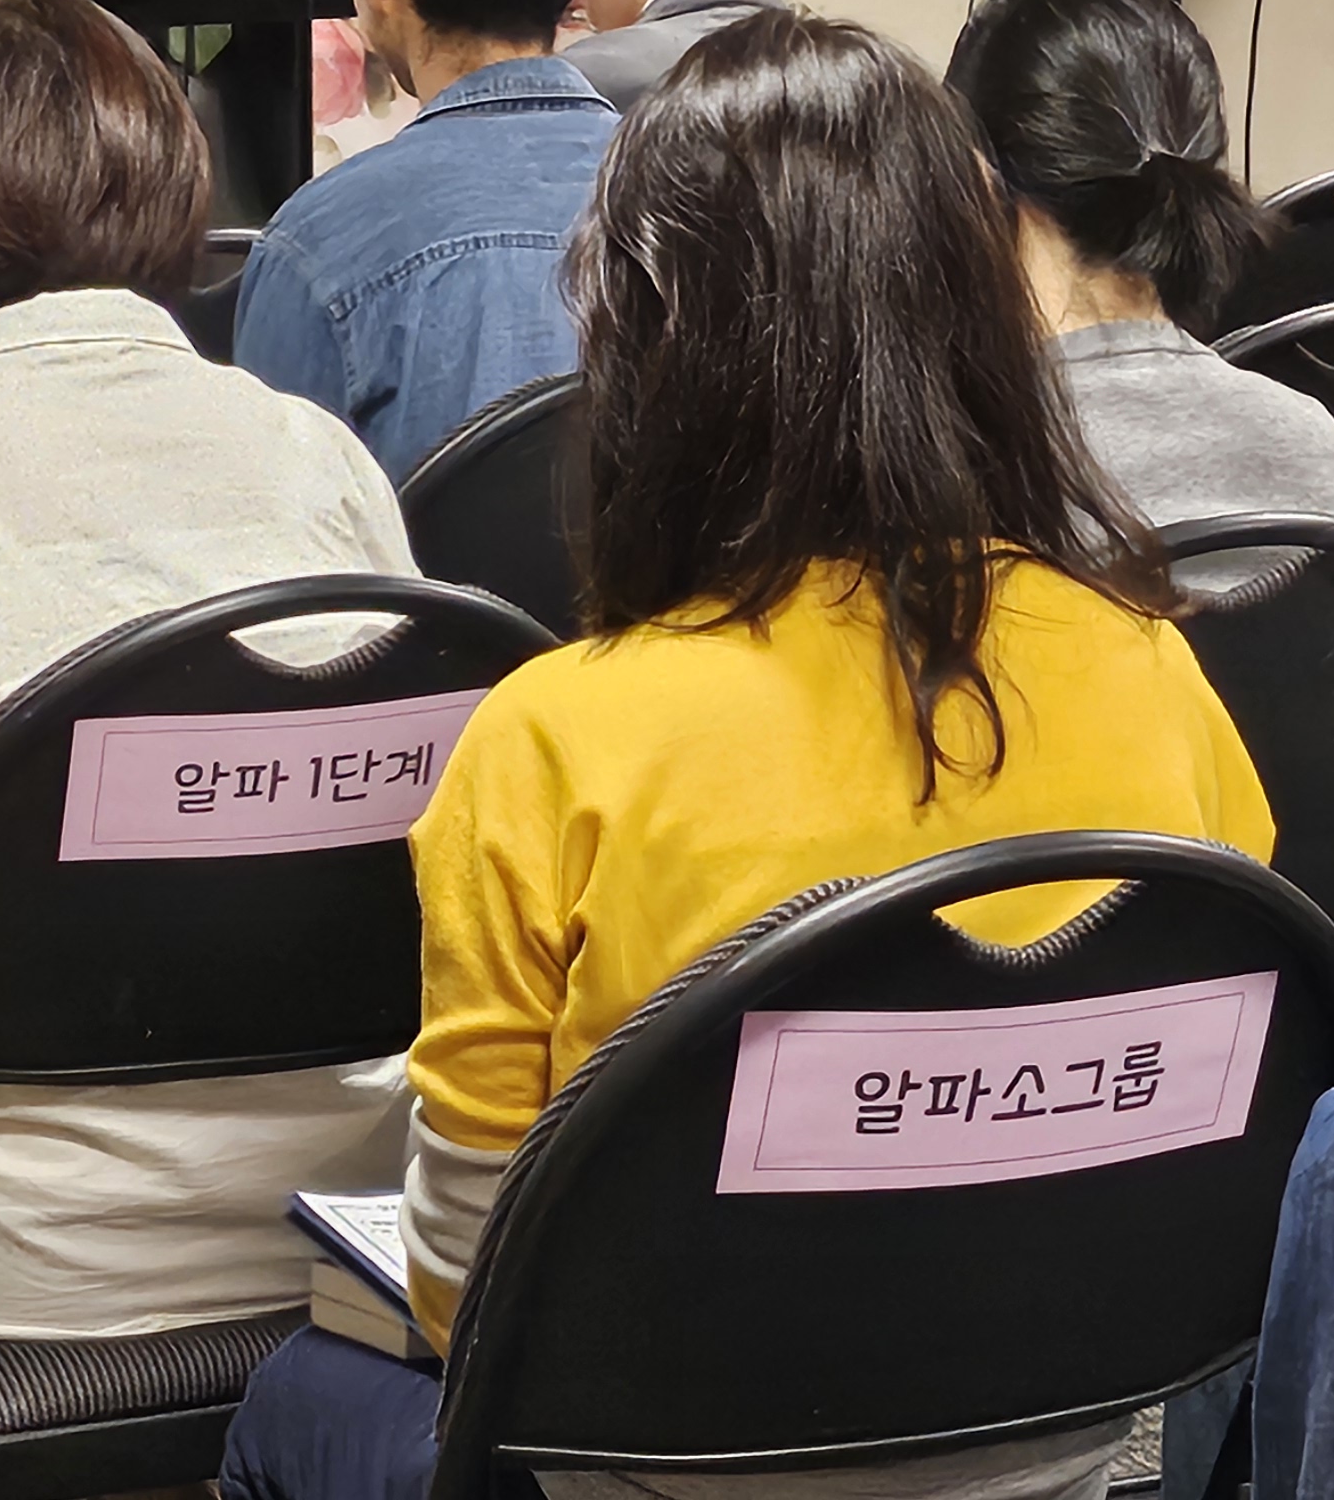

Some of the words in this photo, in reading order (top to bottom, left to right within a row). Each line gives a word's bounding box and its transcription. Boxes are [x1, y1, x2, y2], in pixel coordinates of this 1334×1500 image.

[174, 760, 289, 814] 알파
[310, 742, 435, 802] 1단계
[854, 1040, 1165, 1134] 알파소그룹
